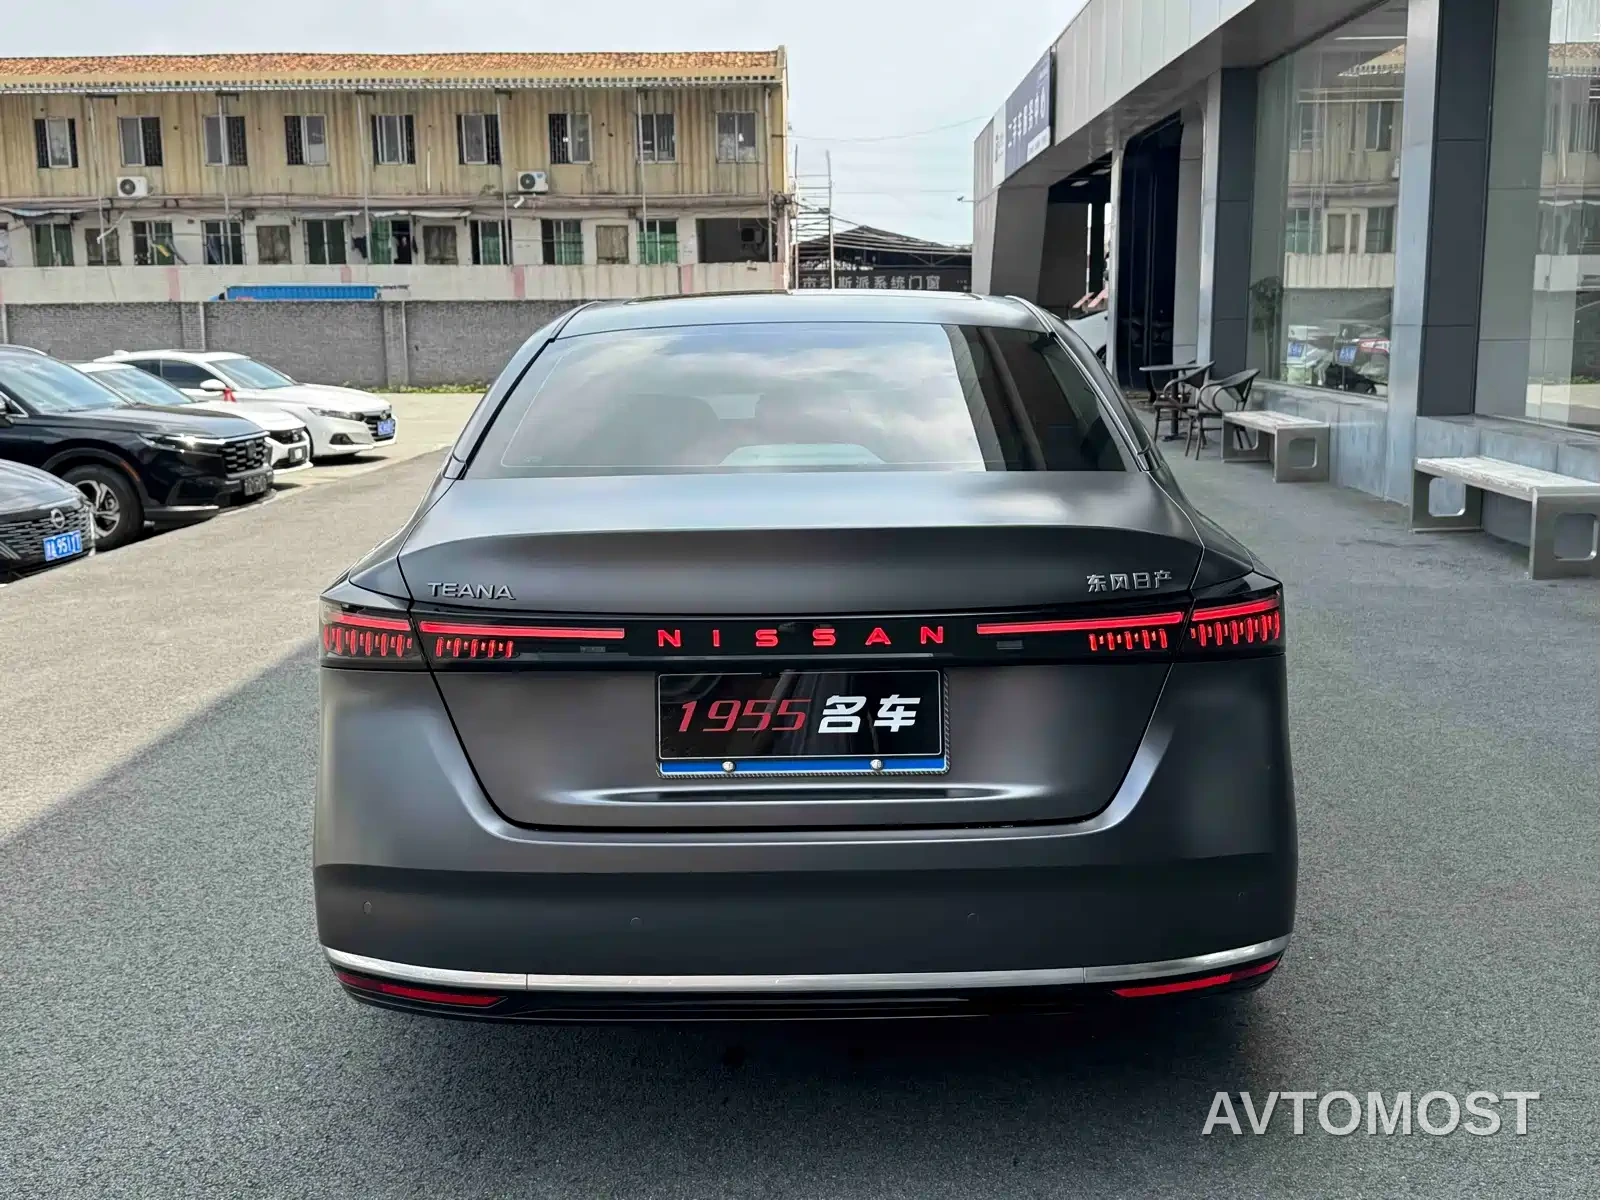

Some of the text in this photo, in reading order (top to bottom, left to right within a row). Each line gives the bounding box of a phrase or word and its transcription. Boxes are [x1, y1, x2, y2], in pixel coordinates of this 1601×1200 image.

[428, 582, 515, 600] TEANA
[1087, 570, 1172, 592] 东风日产
[657, 626, 944, 648] NISSAN
